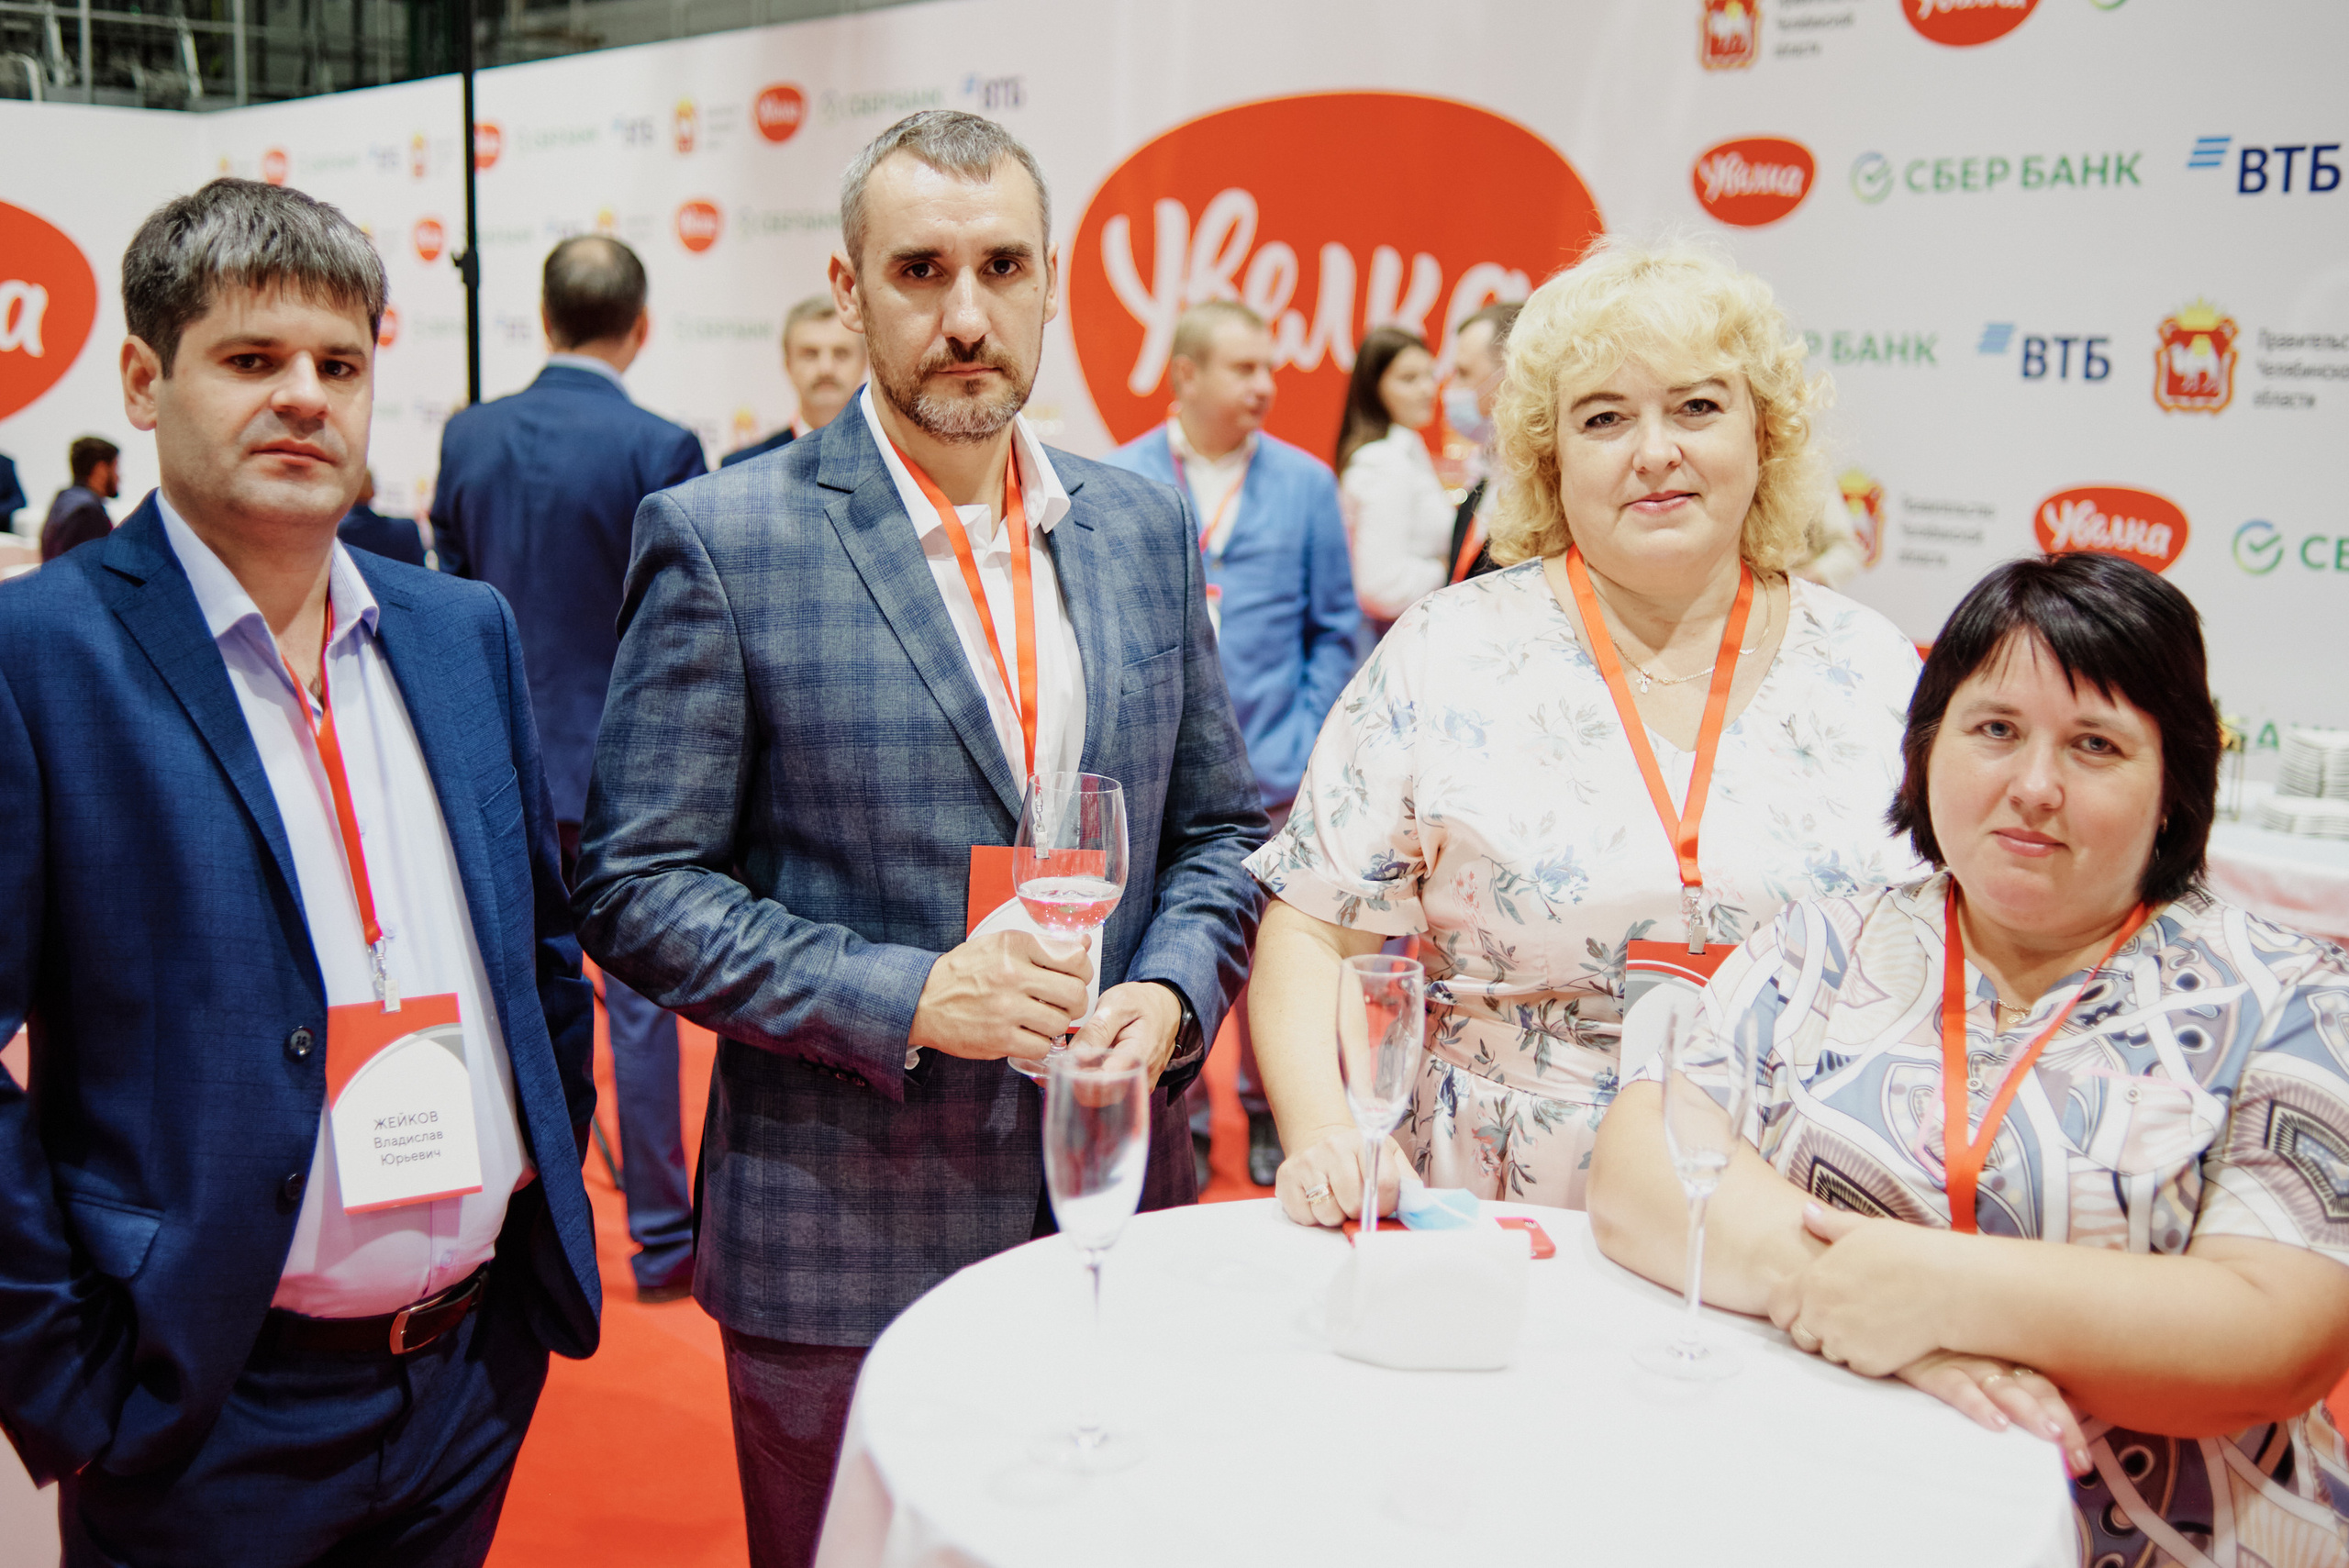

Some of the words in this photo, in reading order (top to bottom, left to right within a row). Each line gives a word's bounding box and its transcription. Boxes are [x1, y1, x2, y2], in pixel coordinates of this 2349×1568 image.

[2237, 143, 2343, 195] ВТБ
[2021, 335, 2112, 381] ВТБ
[374, 1110, 439, 1130] ЖЕЙКОВ
[373, 1131, 443, 1149] Владислав
[382, 1150, 441, 1166] Юрьевич
